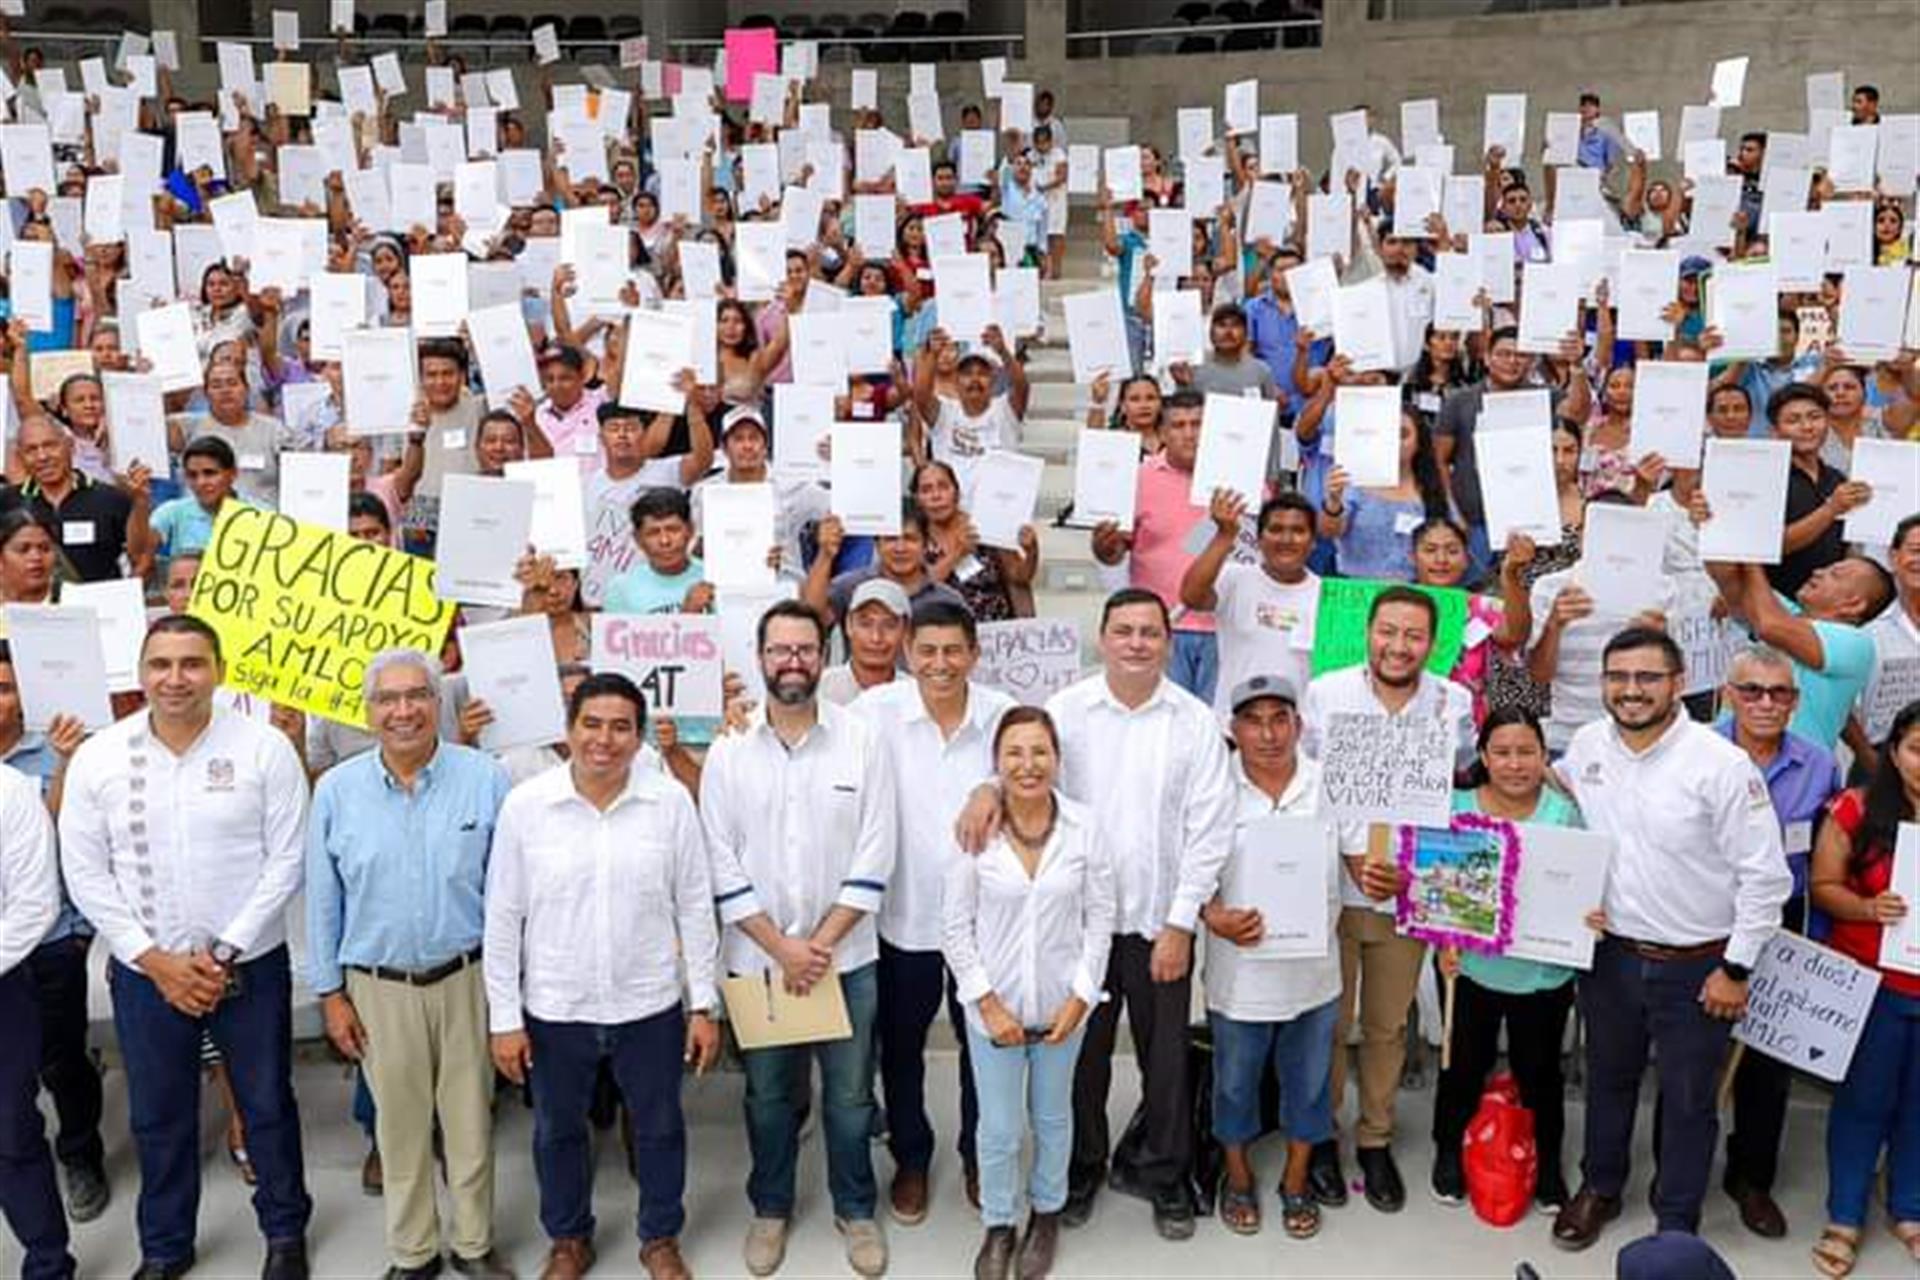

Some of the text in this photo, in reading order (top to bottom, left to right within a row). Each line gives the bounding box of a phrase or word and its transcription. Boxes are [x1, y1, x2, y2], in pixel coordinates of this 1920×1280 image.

[216, 506, 443, 626] GRACIAS
[195, 571, 432, 653] POR SU APOYO
[241, 631, 366, 691] AMLO
[604, 621, 717, 662] Gracias
[289, 676, 313, 700] la
[1352, 770, 1397, 789] LOTE
[1403, 772, 1449, 796] PARA
